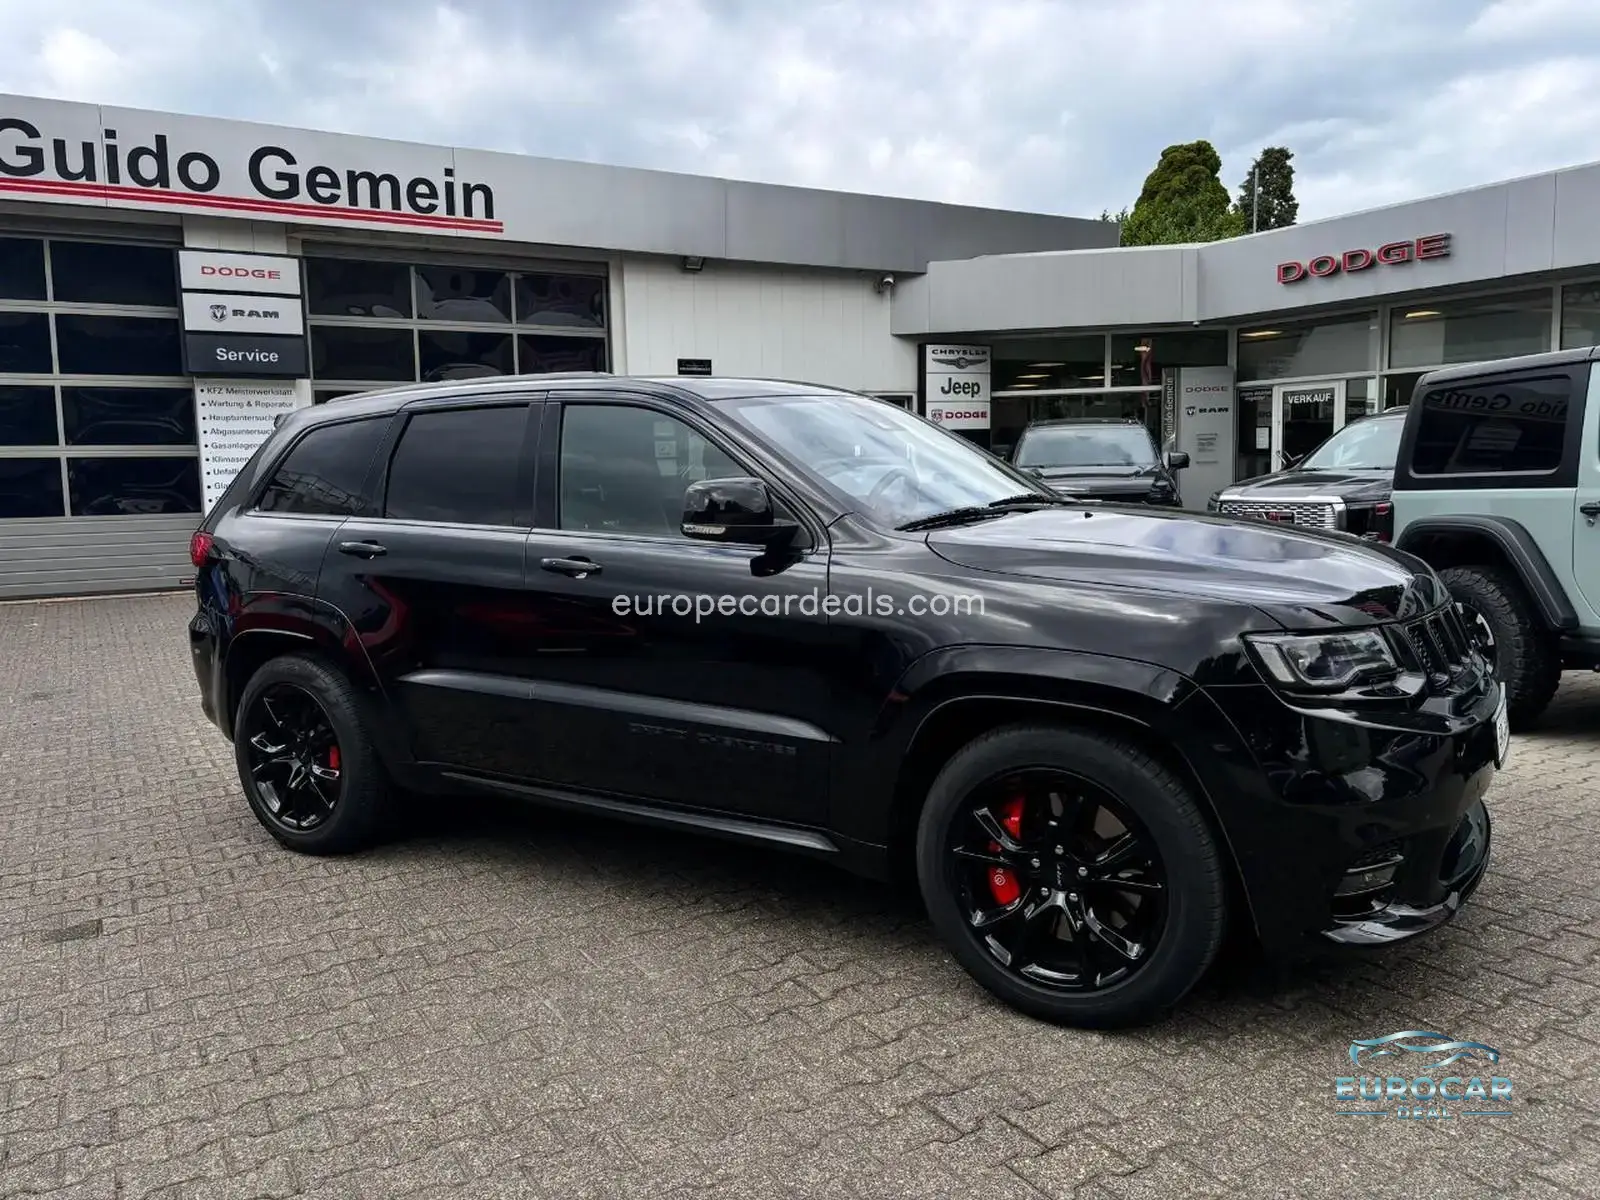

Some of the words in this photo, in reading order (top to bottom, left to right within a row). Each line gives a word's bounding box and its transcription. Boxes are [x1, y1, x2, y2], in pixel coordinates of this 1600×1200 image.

[0, 118, 220, 192] Guido
[248, 145, 495, 220] Gemein
[1276, 233, 1452, 284] DODGE
[201, 265, 281, 280] DODGE
[232, 308, 280, 319] RAM
[215, 347, 280, 363] Service
[206, 387, 224, 395] KFZ
[940, 377, 980, 398] Jeep
[208, 400, 244, 409] Wartung
[254, 400, 293, 408] Reparatur
[1287, 392, 1332, 404] VERKAUF
[945, 411, 988, 419] DODGE
